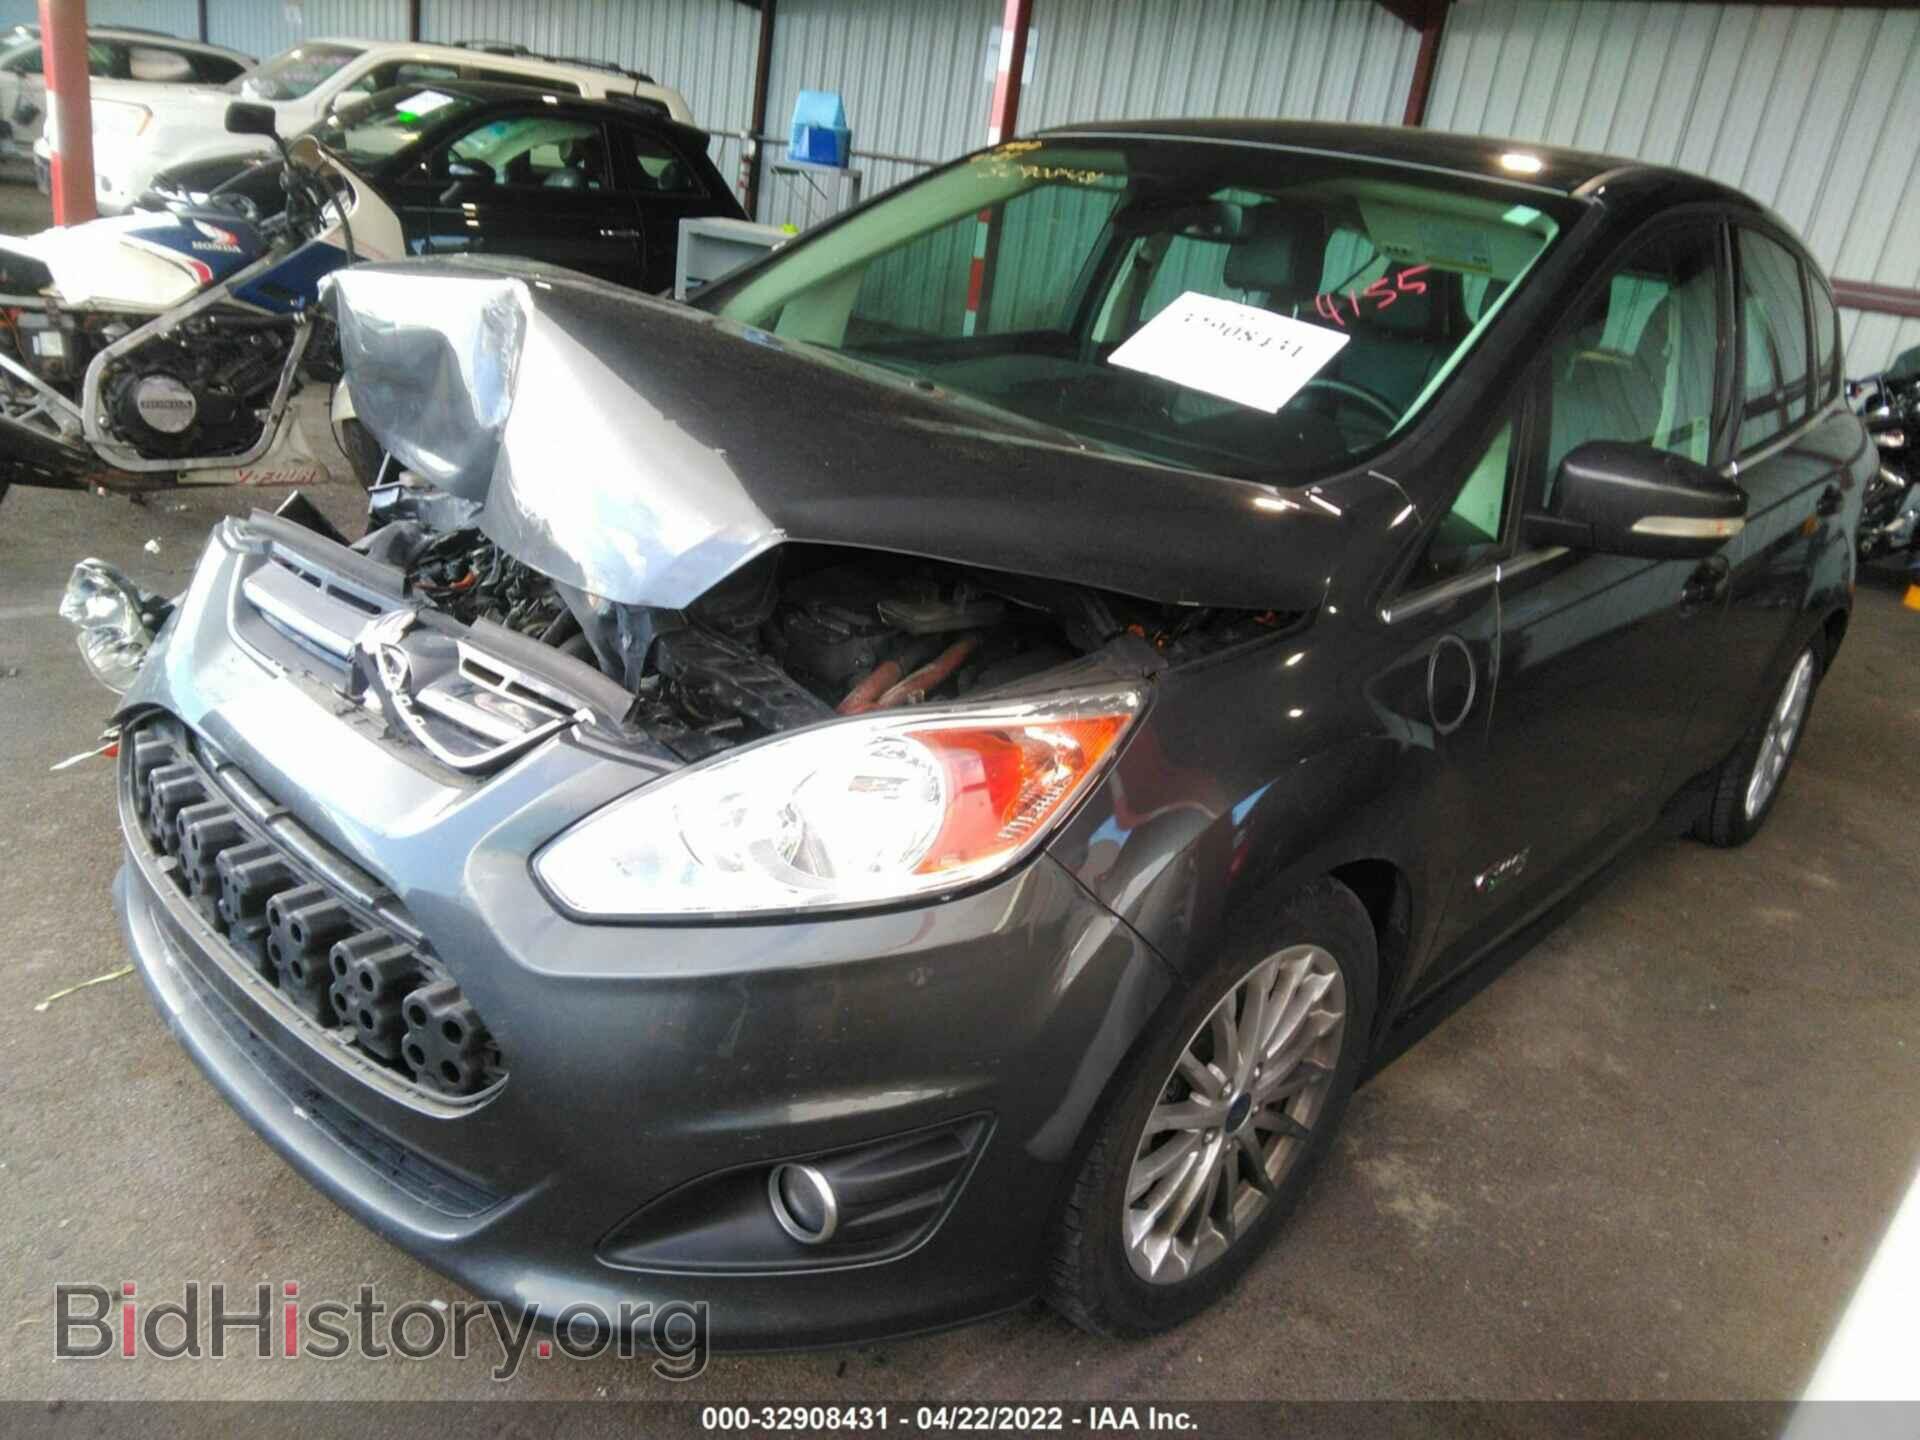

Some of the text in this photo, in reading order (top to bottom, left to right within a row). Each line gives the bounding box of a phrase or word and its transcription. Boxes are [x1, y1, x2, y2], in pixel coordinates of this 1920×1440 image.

[191, 240, 242, 254] HONDA
[1315, 263, 1431, 326] 4155
[139, 399, 194, 410] HONDA
